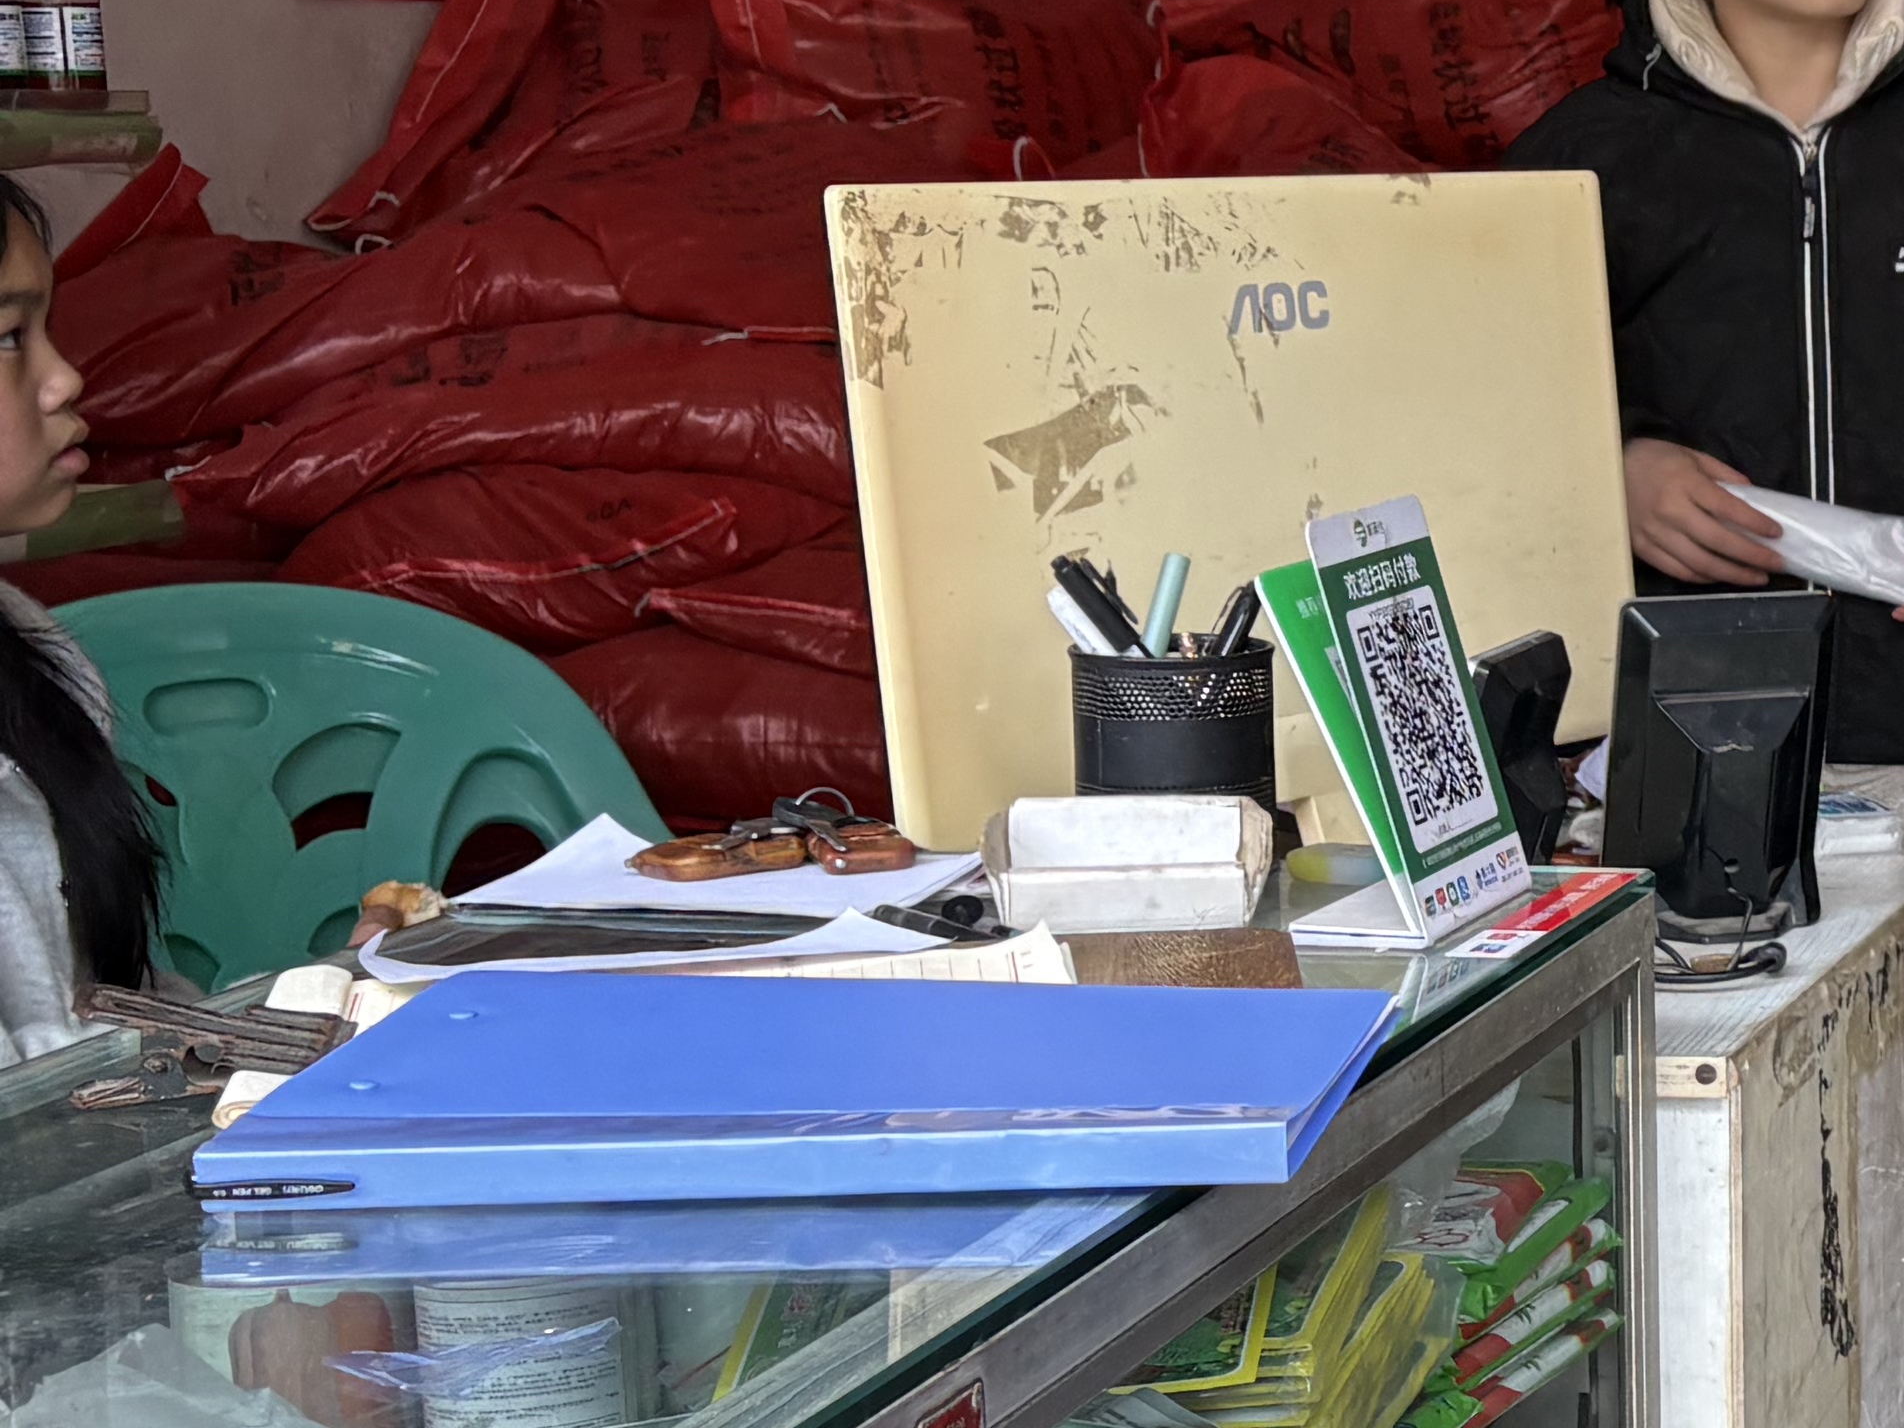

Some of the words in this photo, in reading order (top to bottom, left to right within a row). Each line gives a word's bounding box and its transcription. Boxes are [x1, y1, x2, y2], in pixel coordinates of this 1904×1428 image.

[1228, 280, 1330, 334] AOC
[1343, 552, 1421, 600] 欢迎扫码付款
